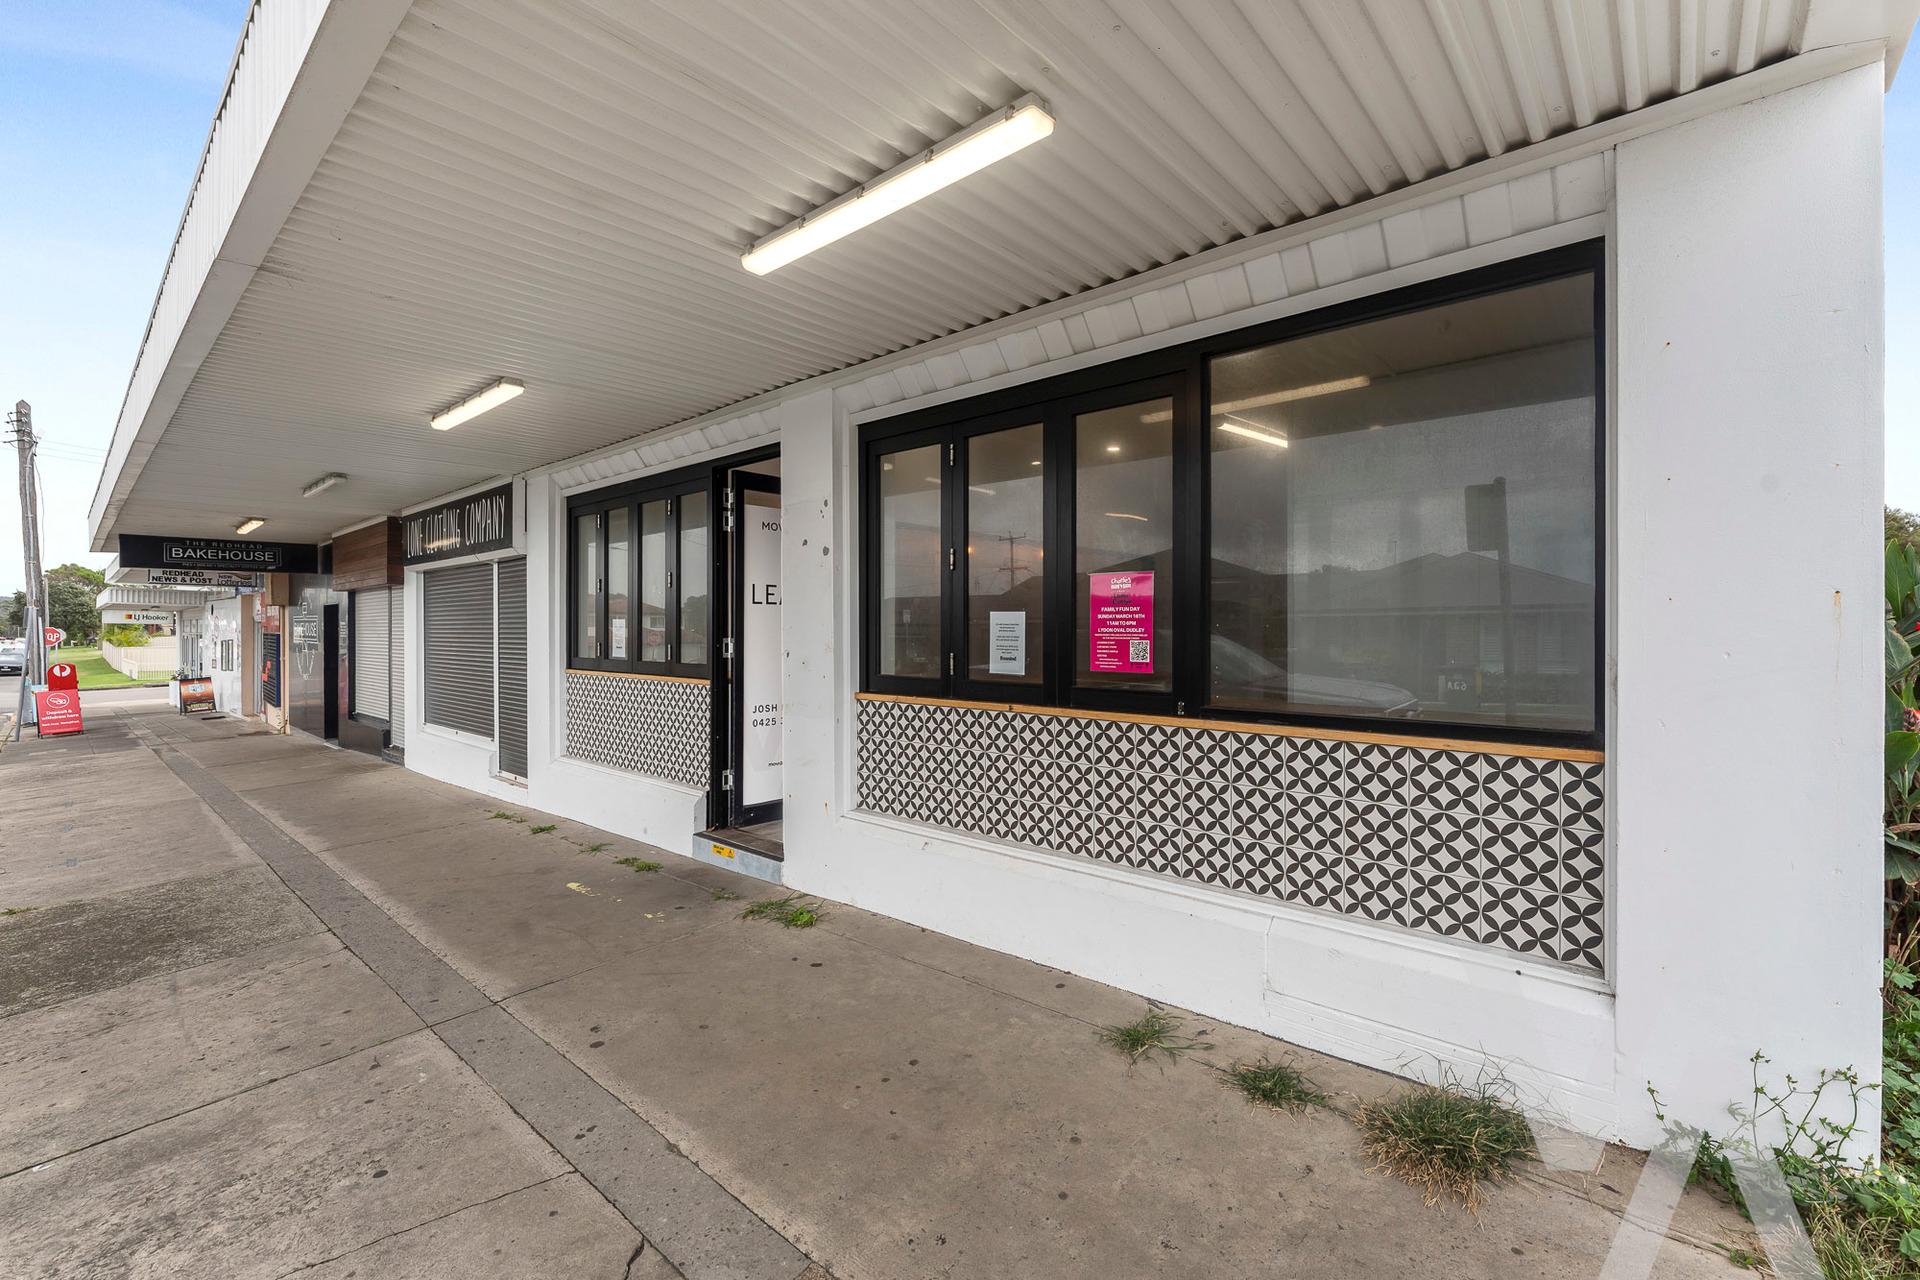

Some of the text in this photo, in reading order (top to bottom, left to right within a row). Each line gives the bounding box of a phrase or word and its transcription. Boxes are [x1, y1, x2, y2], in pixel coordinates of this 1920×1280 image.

[407, 495, 505, 559] LONE CLOTHING COMPANY
[212, 541, 263, 549] REDHEAD
[171, 547, 274, 562] BAKEHOUSE
[162, 569, 204, 577] REDHEAD
[151, 575, 178, 583] NEWS
[751, 583, 782, 605] LE
[752, 704, 777, 713] JOSH
[752, 717, 777, 728] 0425
